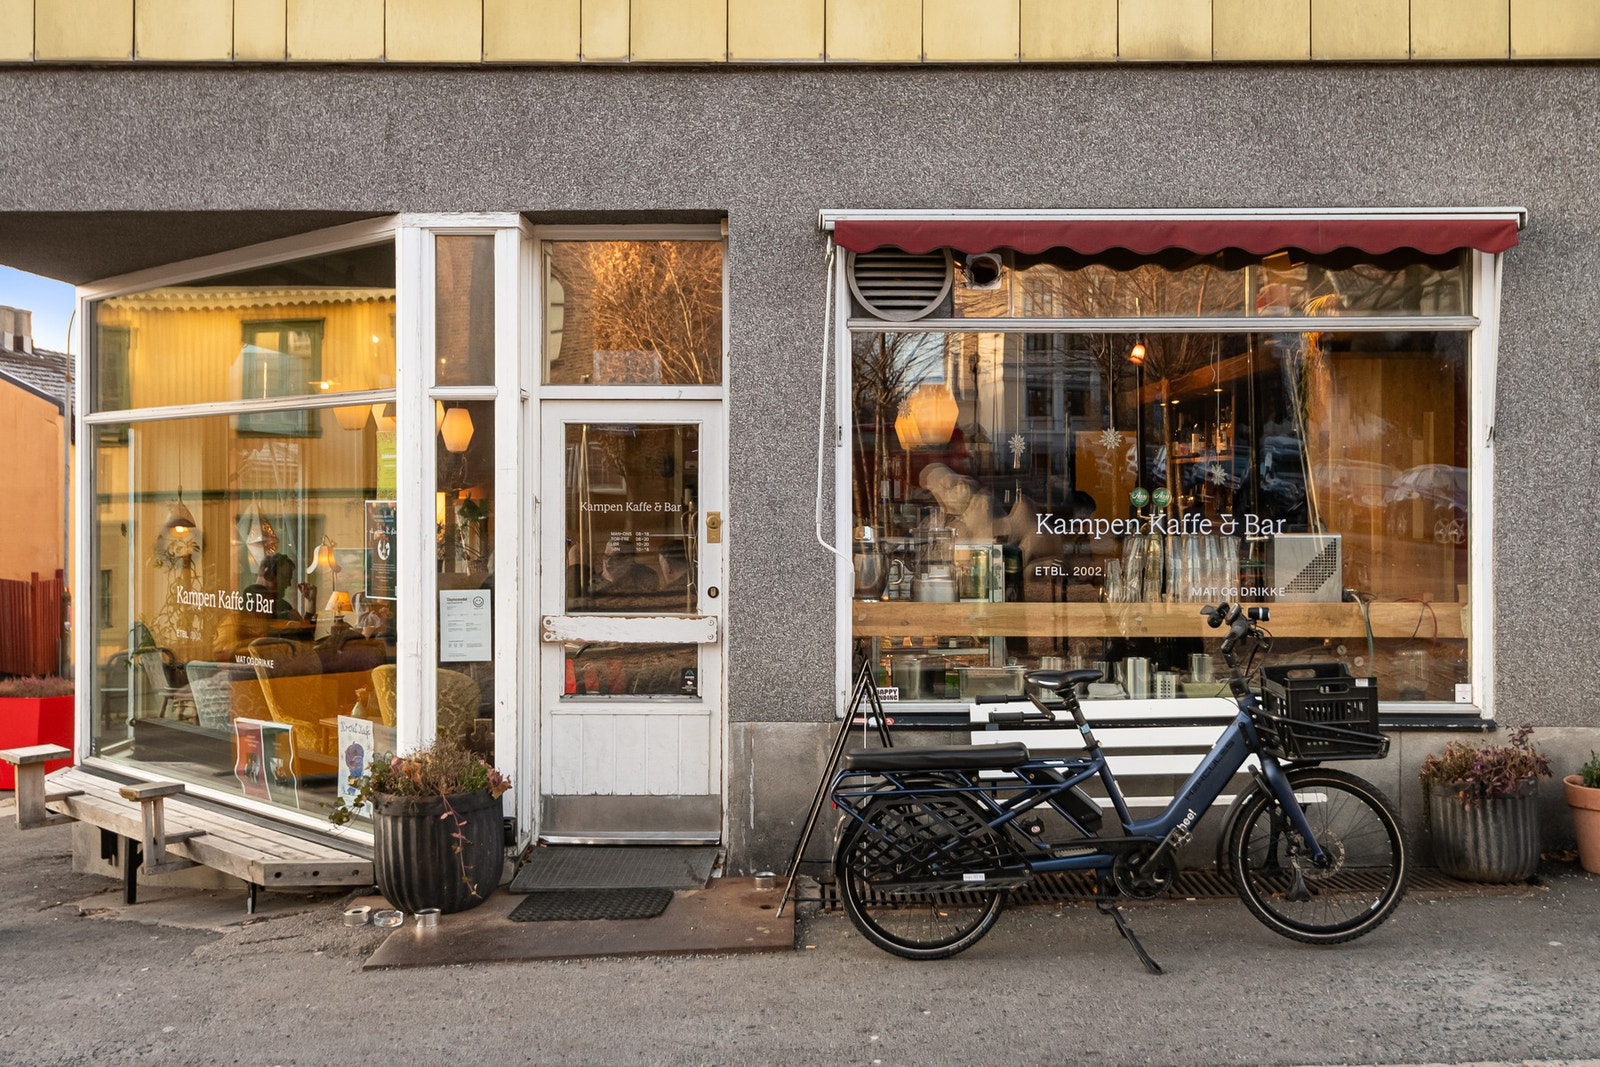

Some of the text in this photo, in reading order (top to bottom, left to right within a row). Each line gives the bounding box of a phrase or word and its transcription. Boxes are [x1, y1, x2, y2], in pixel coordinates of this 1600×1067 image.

[580, 502, 682, 513] Kampen Kaffe & Bar
[1035, 513, 1287, 539] Kampen Kaffe & Bar
[1035, 566, 1102, 577] ETBL. 2002
[1191, 587, 1286, 597] MAT OG DRIKKE
[176, 585, 275, 614] Kampen Kaffe & Bar
[235, 654, 275, 669] MAT OG DRIKKE
